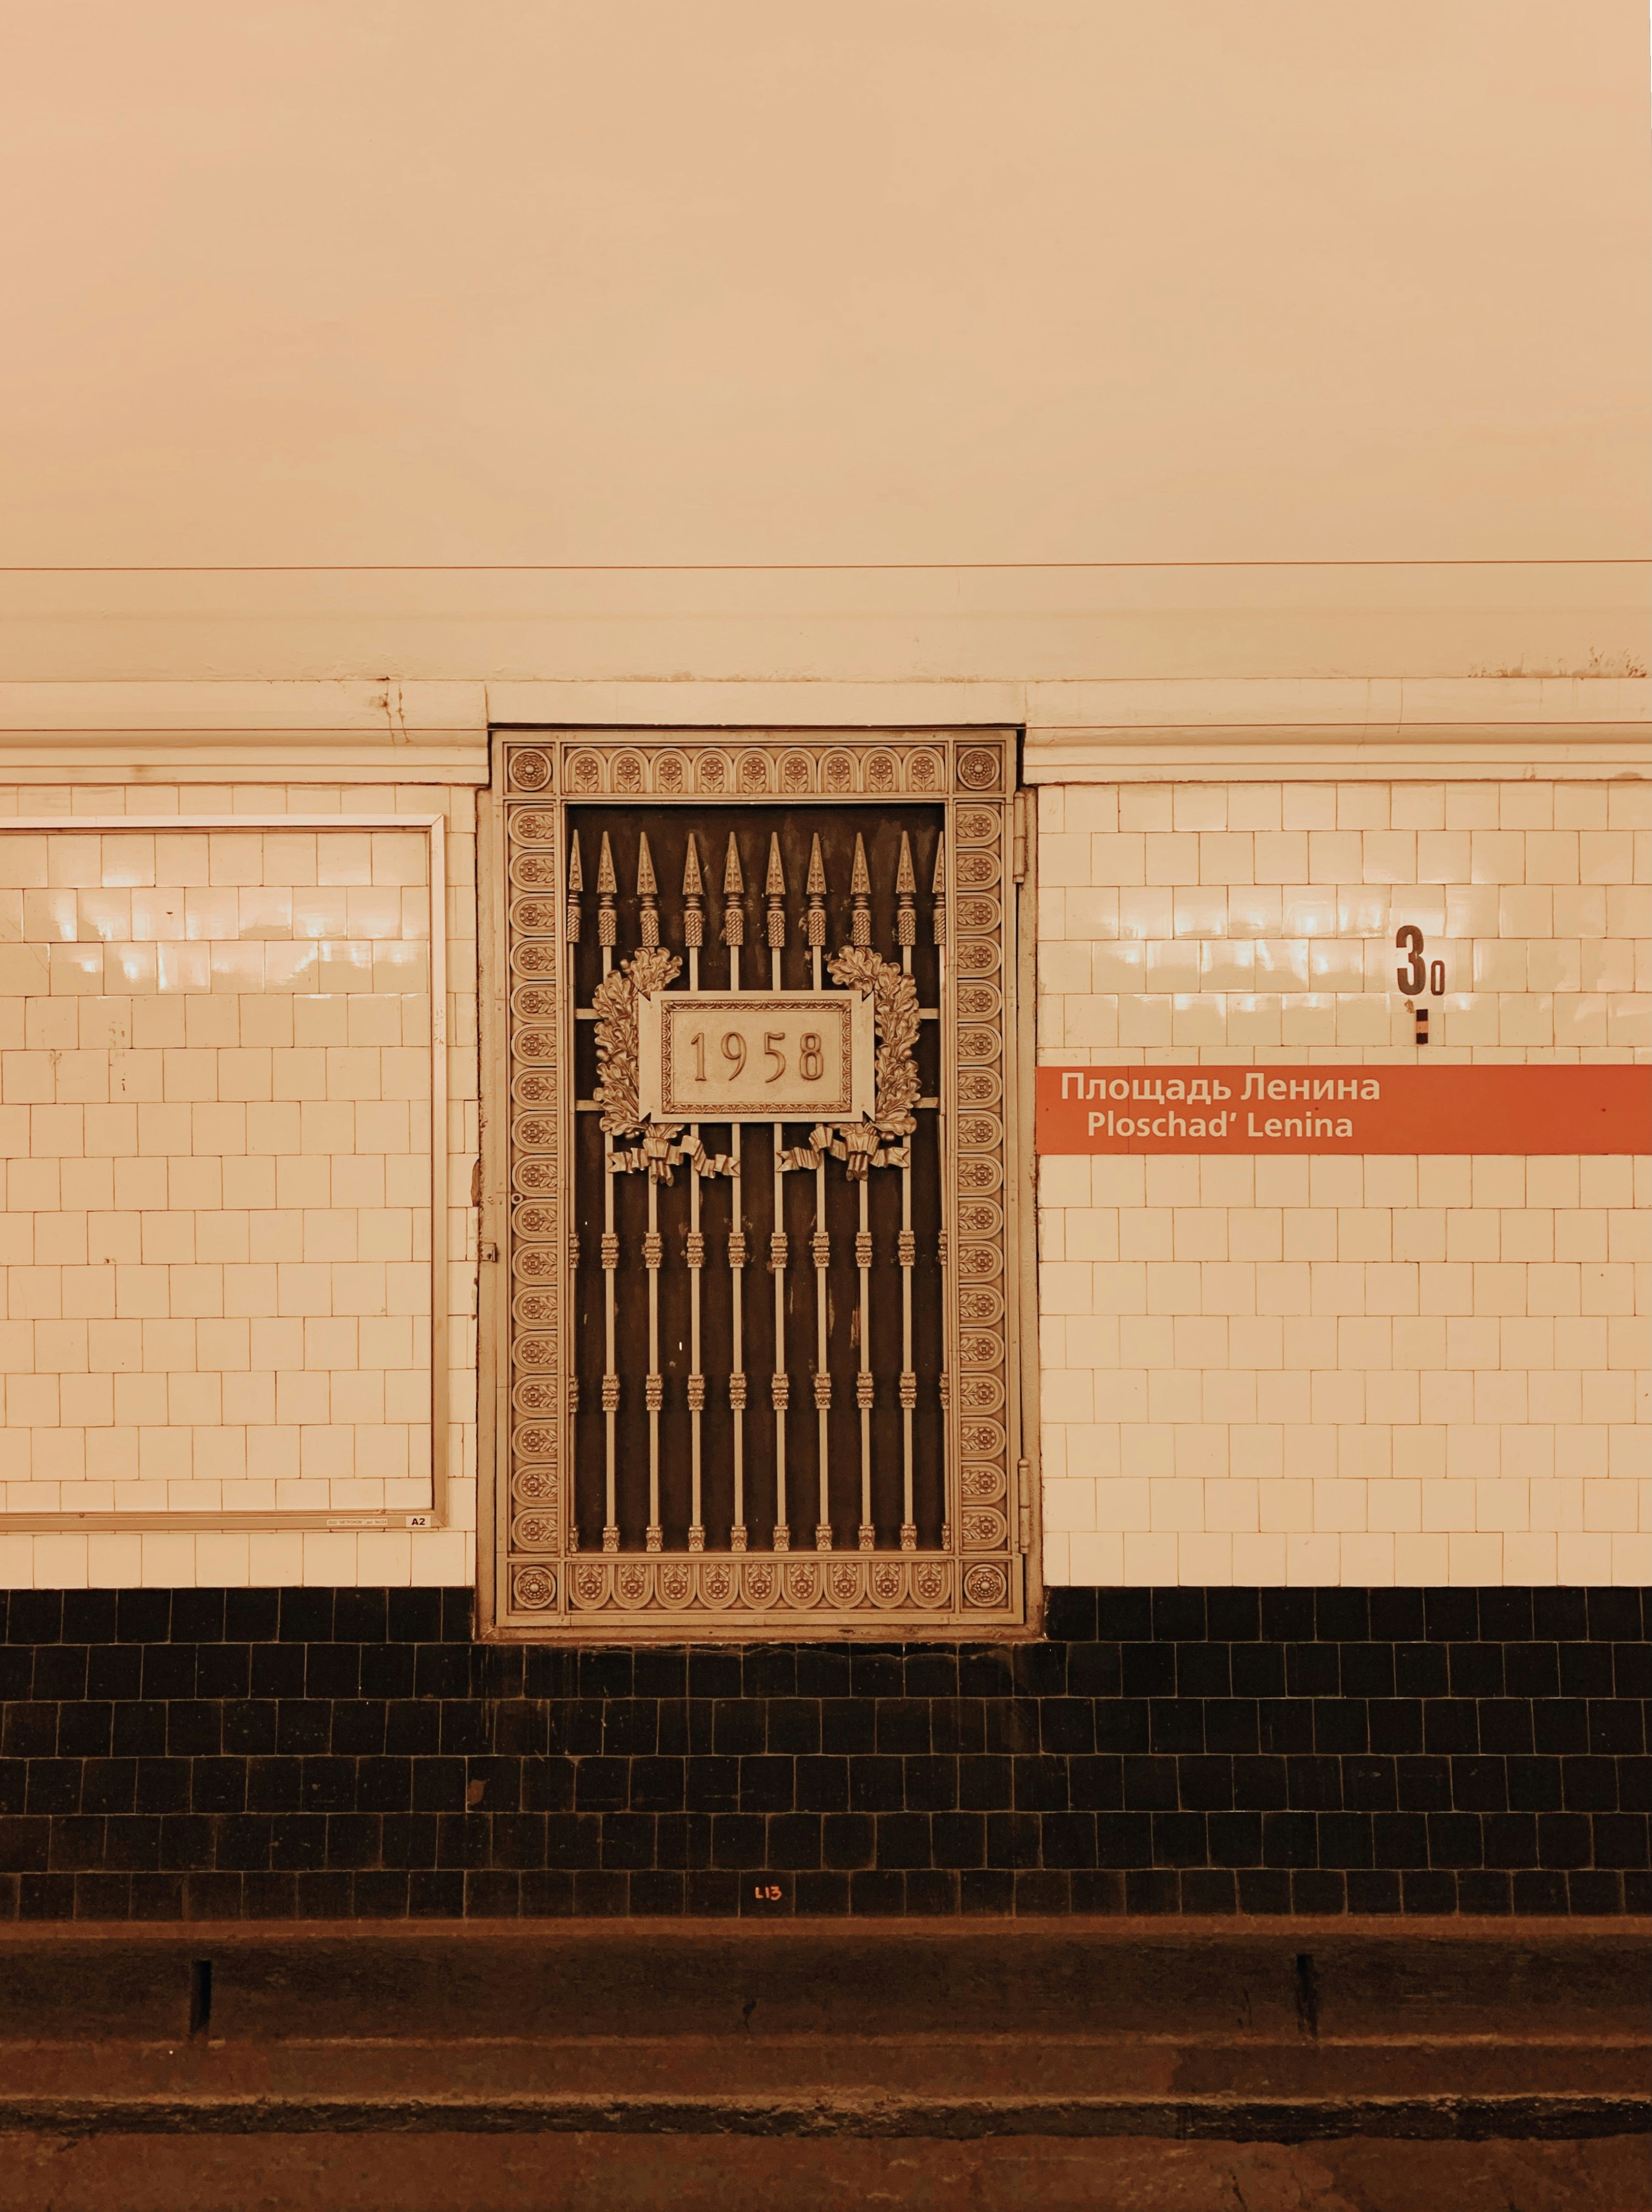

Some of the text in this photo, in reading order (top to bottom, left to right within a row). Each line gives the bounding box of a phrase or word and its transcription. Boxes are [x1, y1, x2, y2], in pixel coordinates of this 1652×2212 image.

[691, 1031, 824, 1083] 1958
[1062, 1072, 1380, 1105] Площадь Ленина
[1247, 1111, 1354, 1137] Lenina
